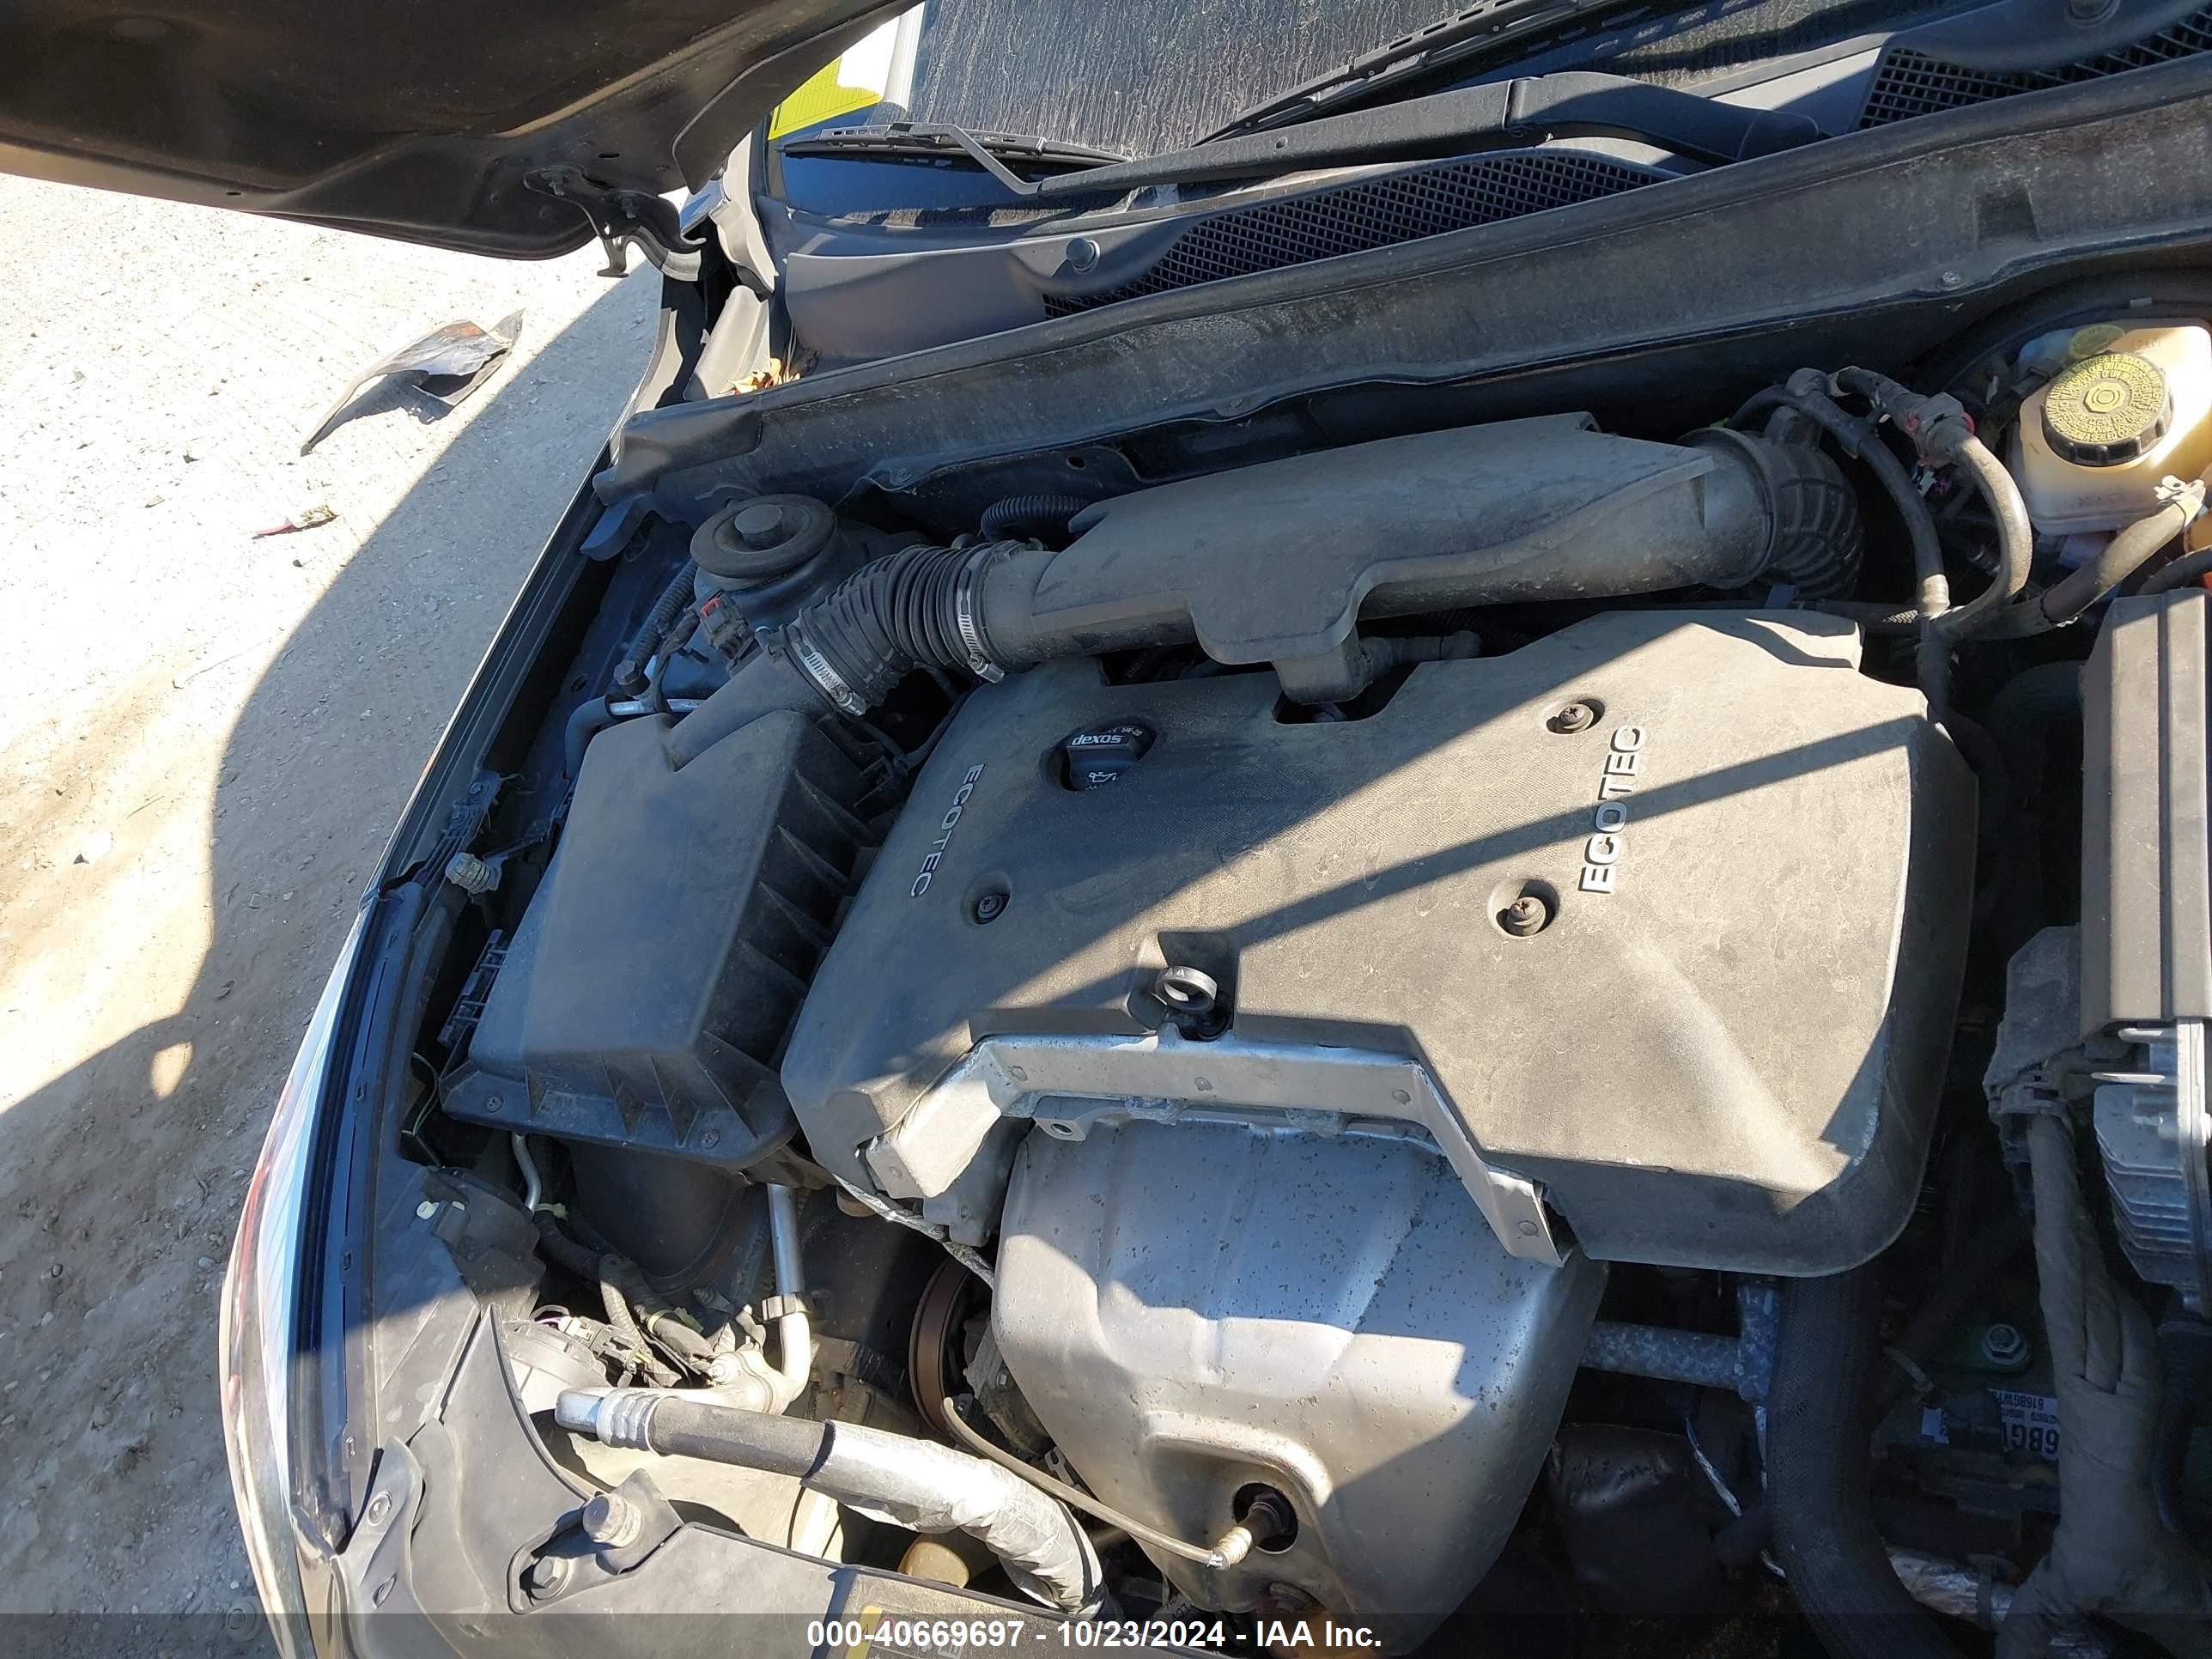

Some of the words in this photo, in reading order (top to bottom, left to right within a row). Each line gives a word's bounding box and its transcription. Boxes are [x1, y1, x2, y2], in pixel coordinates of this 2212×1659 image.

[1072, 734, 1123, 745] dexos
[910, 763, 986, 898] ECOTEC
[1580, 724, 1646, 894] ECOTEC
